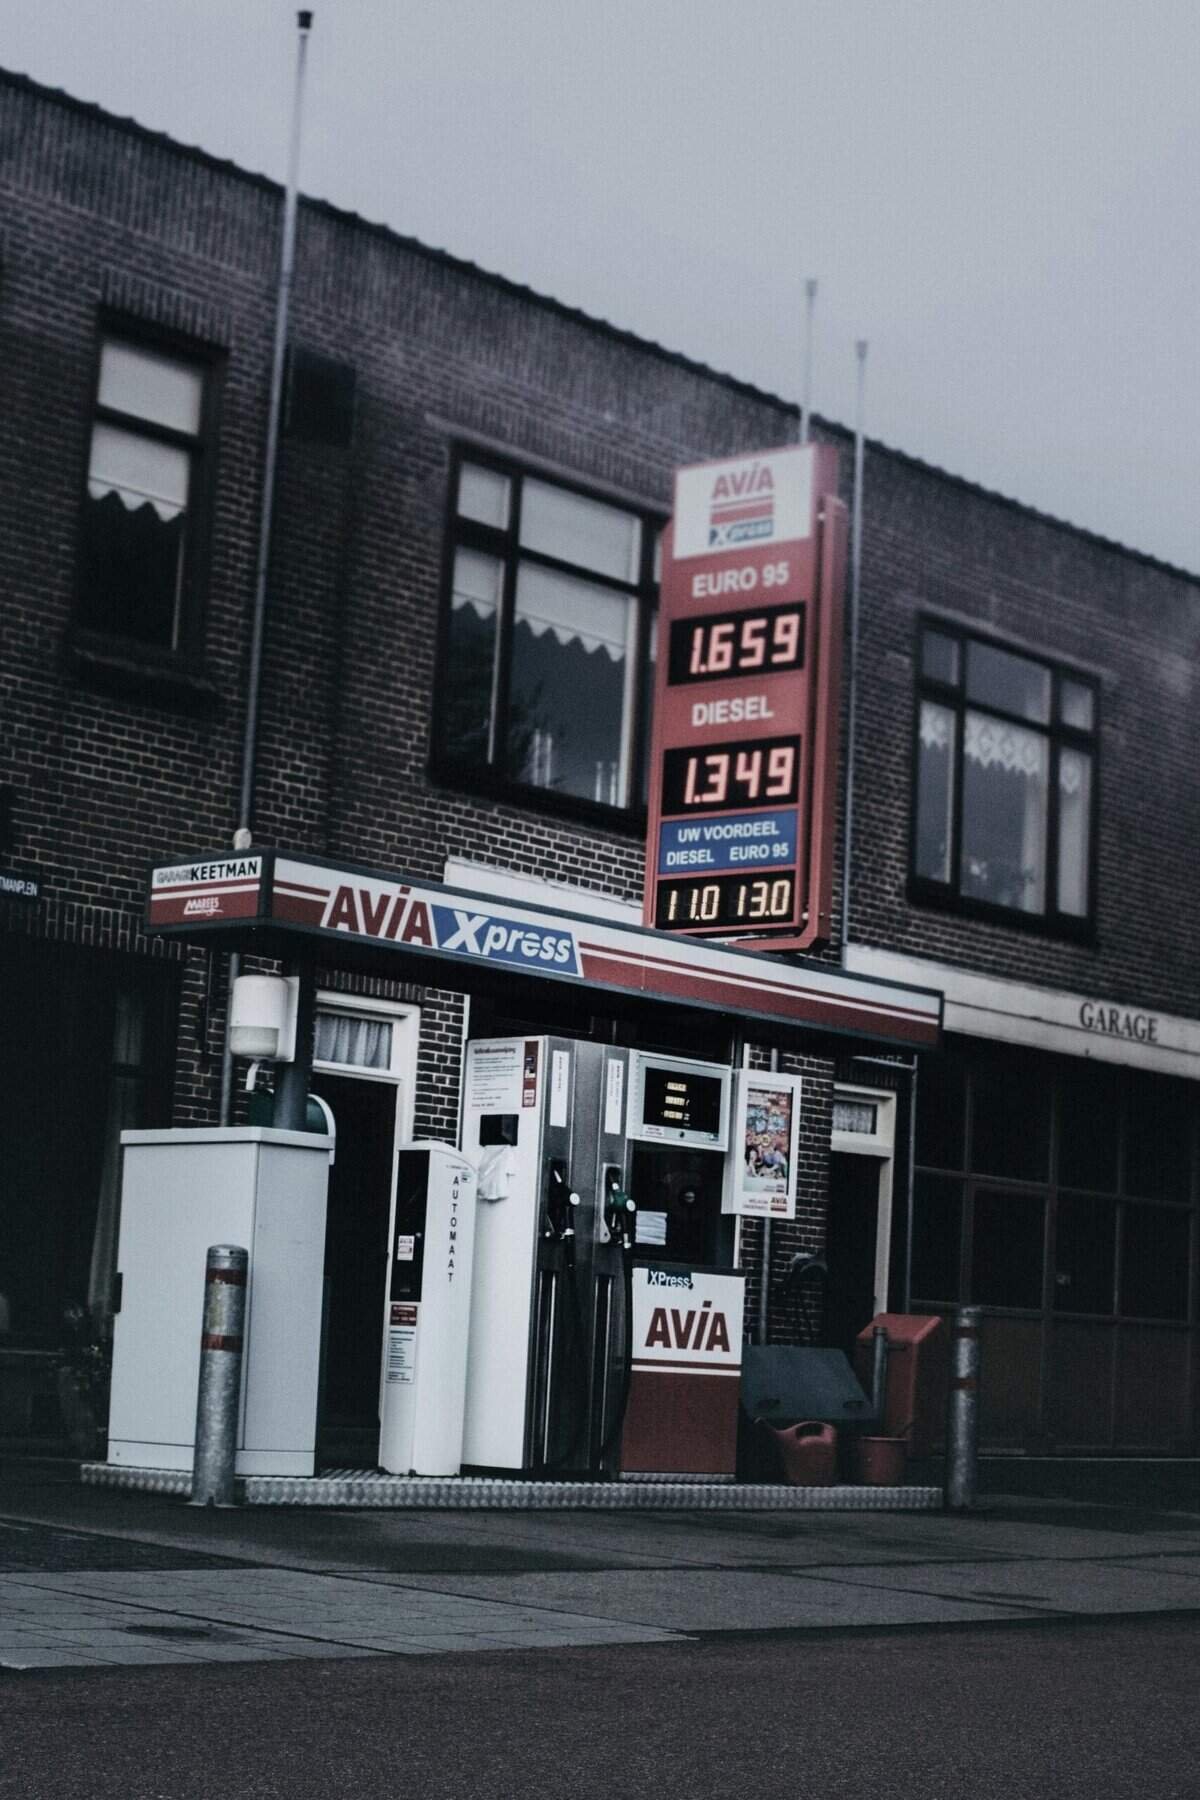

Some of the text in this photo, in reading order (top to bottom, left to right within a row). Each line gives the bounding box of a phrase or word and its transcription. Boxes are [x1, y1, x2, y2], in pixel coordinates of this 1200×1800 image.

[692, 563, 789, 598] EURO 95
[690, 613, 800, 674] 1.659
[691, 696, 774, 727] DIESEL
[684, 747, 795, 804] 1.349
[678, 821, 780, 843] UW VOORDEEL
[666, 850, 715, 866] DIESEL
[730, 843, 789, 861] EURO 95
[191, 861, 258, 881] KEETMAN
[737, 879, 791, 918] 13.0
[327, 886, 572, 963] AVIA Xpress
[1079, 1001, 1158, 1043] GARAGE
[448, 1175, 460, 1282] AUTOMAAT
[649, 1271, 690, 1288] XPress
[645, 1300, 731, 1352] AVIA
